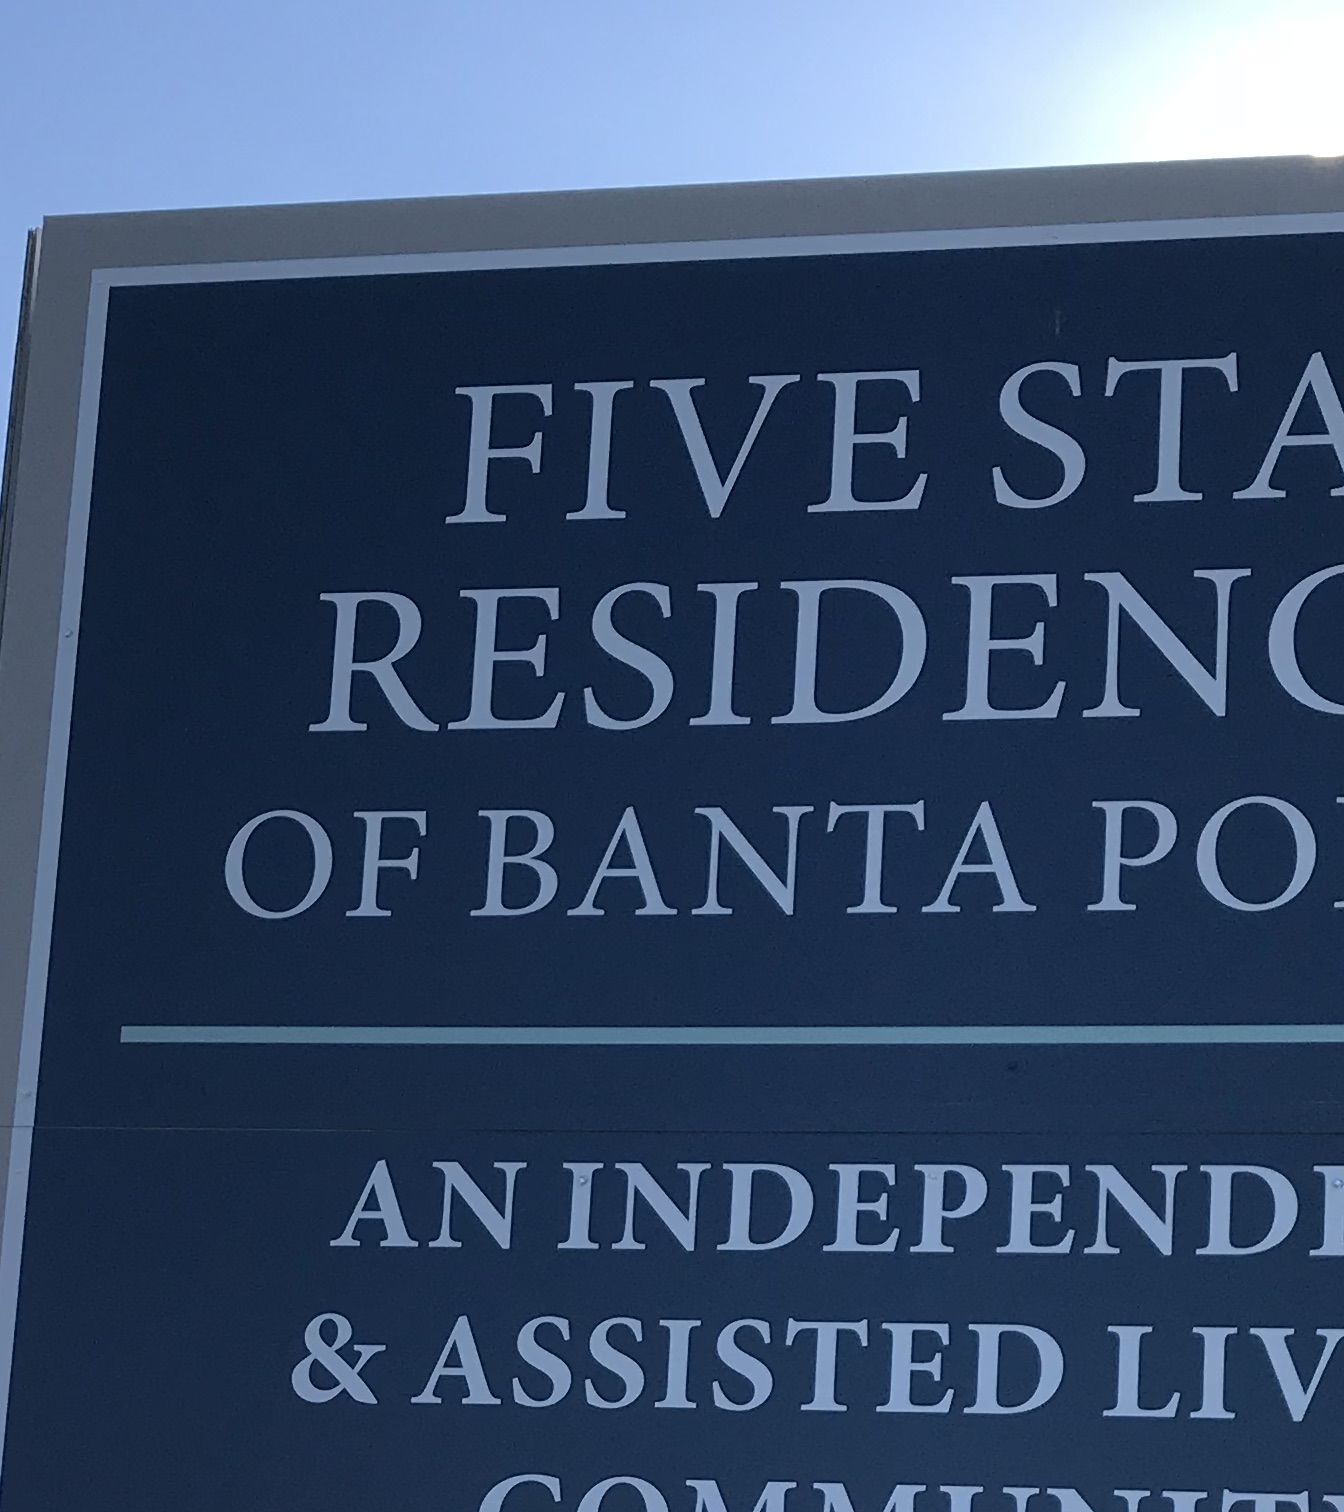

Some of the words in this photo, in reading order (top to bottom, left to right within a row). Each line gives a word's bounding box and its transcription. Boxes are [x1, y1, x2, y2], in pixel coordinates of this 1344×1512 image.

[446, 370, 927, 523] FIVE
[225, 810, 426, 918] OF
[470, 800, 1036, 916] BANTA
[330, 1160, 527, 1249] AN
[292, 1313, 386, 1404] &
[411, 1316, 1063, 1414] ASSISTED
